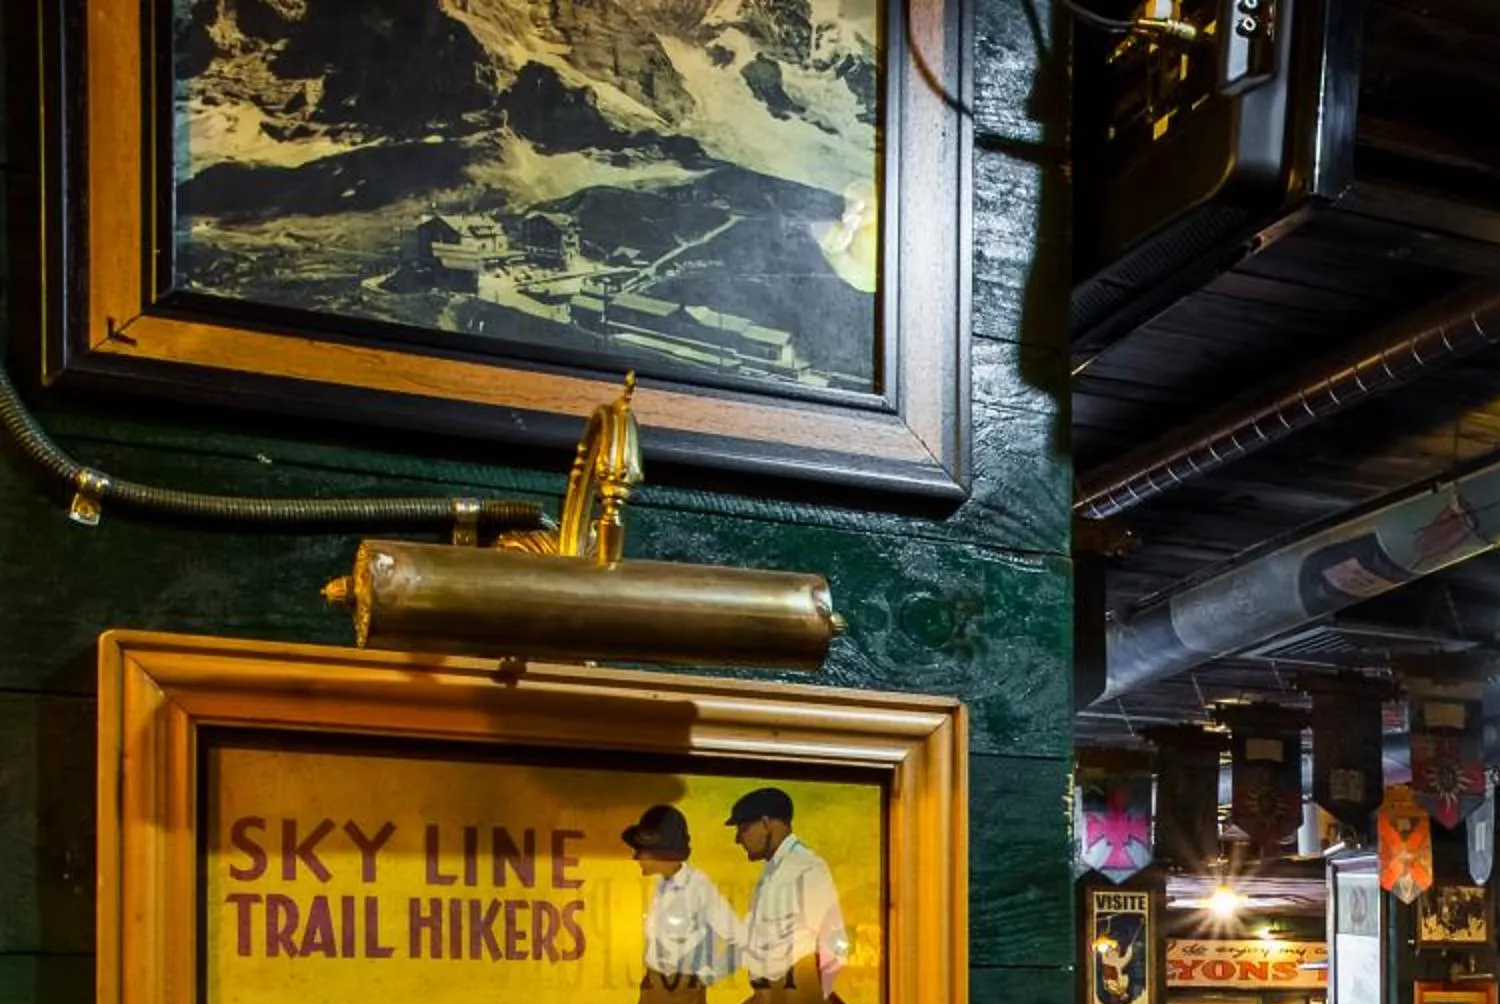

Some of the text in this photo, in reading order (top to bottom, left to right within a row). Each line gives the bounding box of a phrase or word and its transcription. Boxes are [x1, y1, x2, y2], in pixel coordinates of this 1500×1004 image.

[229, 816, 585, 890] SKY LINE
[225, 893, 396, 960] TRAIL
[408, 897, 587, 966] HIKERS
[1096, 893, 1147, 912] VISITE
